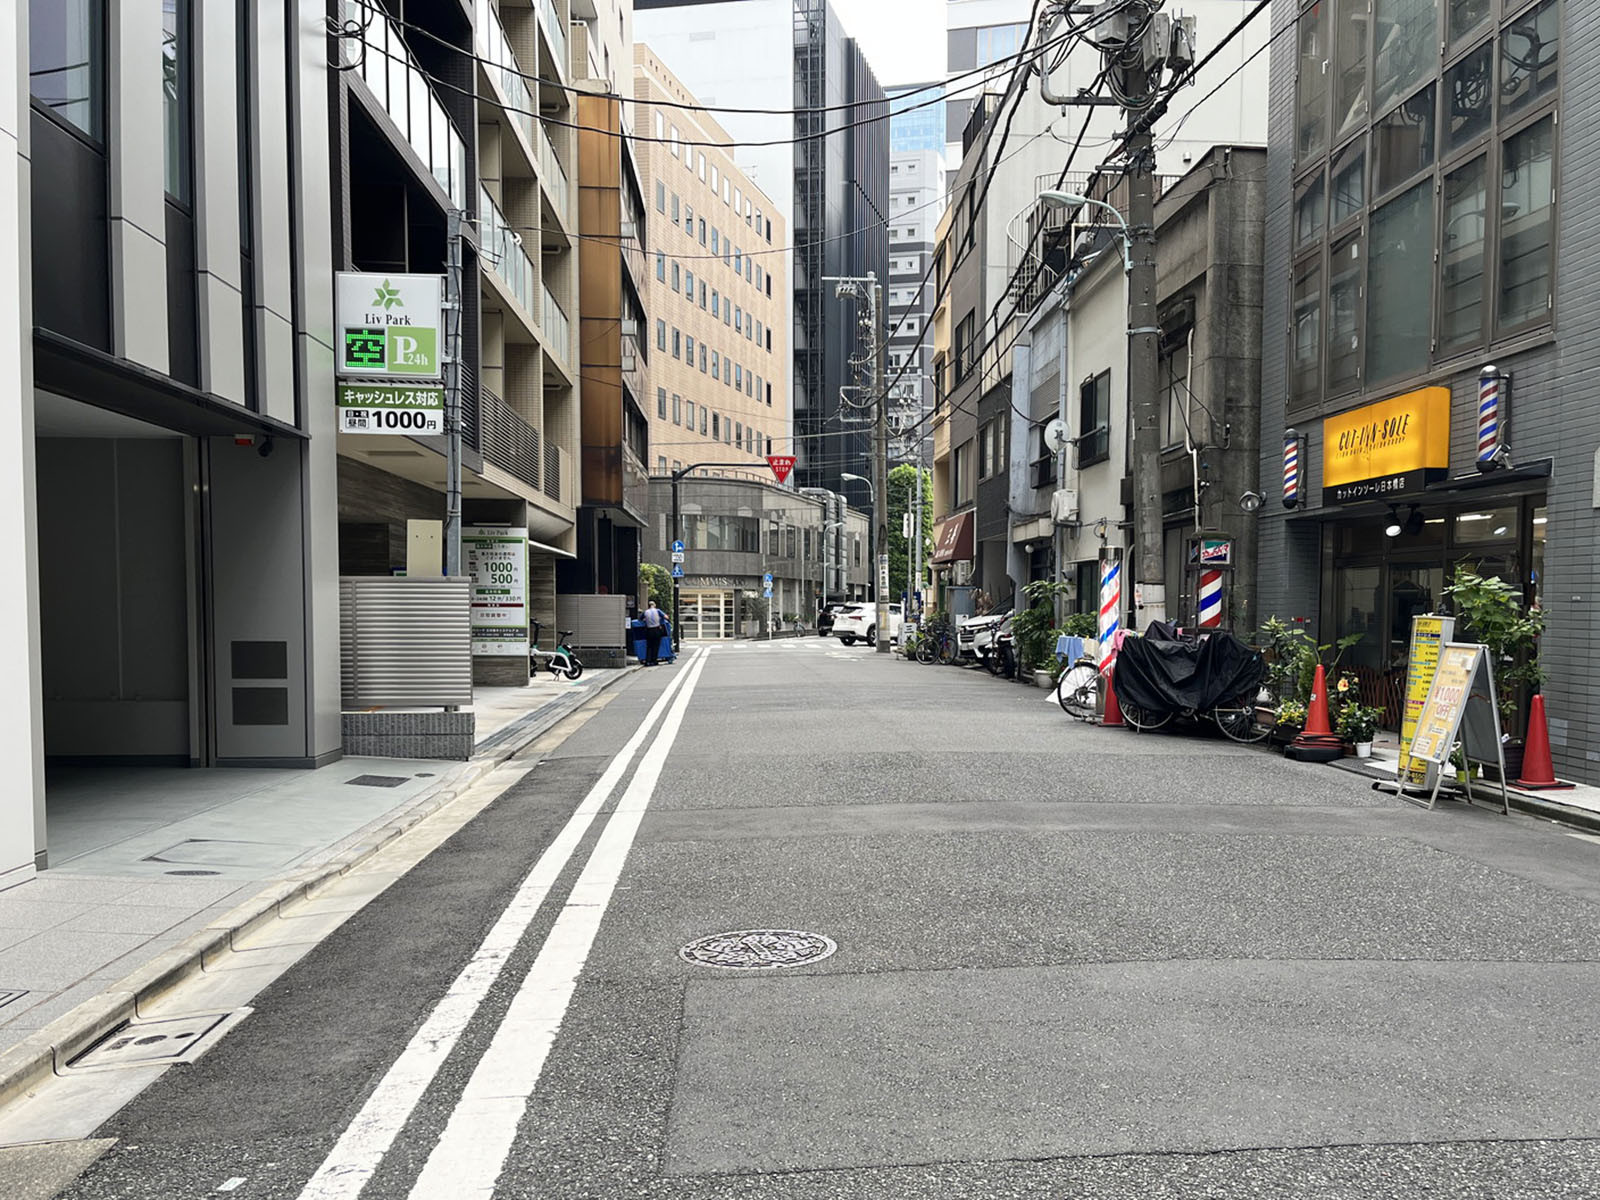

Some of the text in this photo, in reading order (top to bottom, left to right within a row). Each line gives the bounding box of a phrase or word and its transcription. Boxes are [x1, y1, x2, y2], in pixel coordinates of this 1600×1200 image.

[365, 313, 411, 326] Liv Park
[346, 329, 385, 368] 空
[407, 353, 428, 366] 24h
[344, 389, 439, 406] キャッシュレス対応
